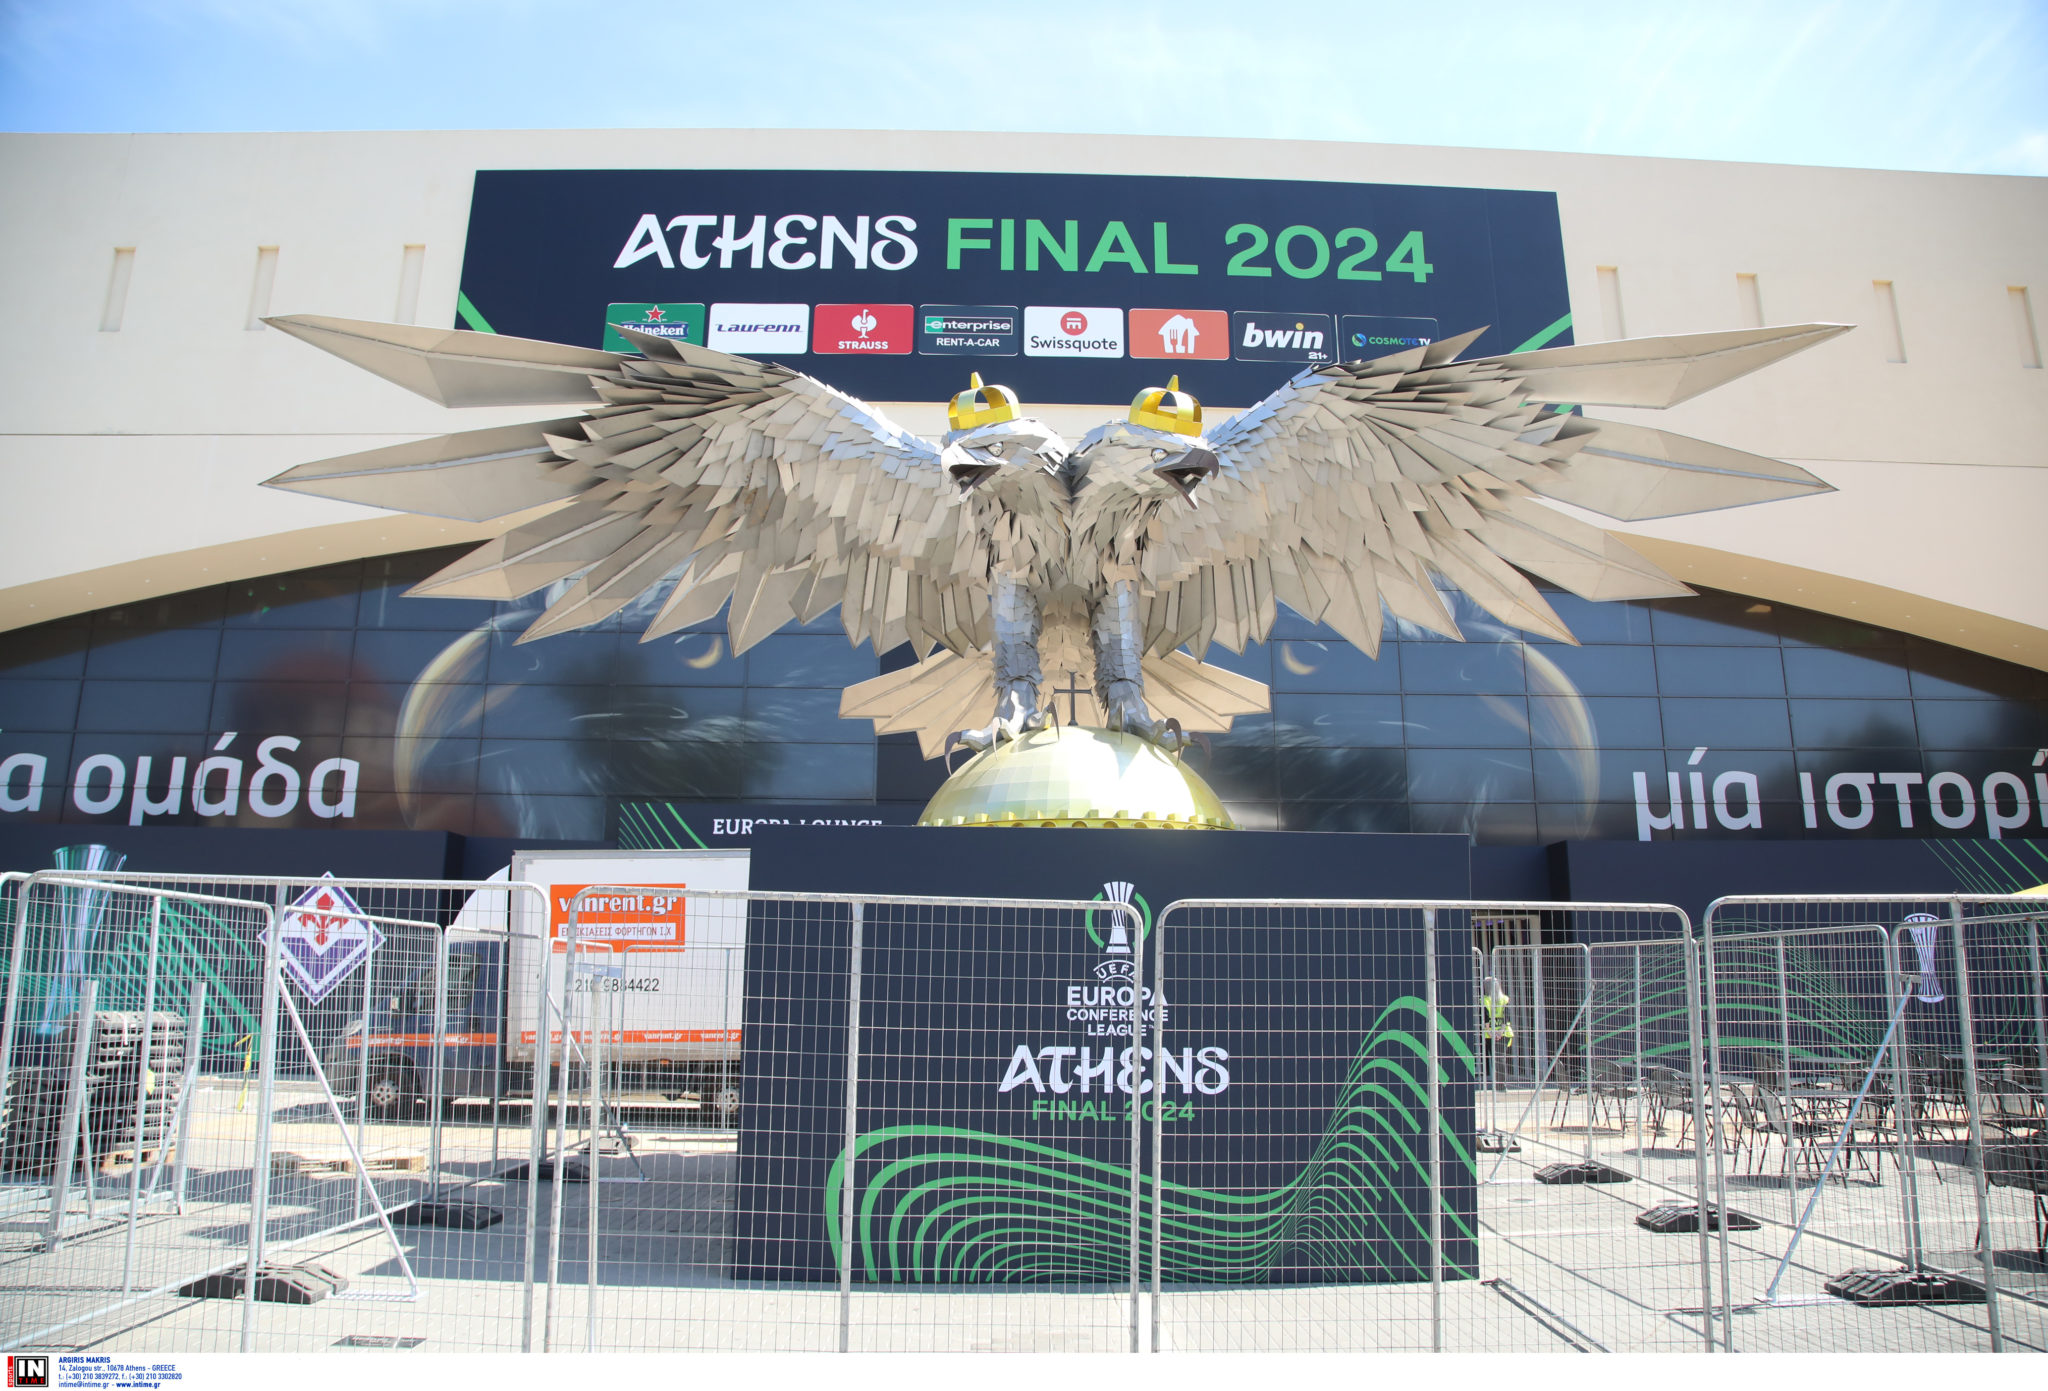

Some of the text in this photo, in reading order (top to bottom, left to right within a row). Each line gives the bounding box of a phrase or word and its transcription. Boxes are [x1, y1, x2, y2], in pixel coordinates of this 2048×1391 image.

[613, 213, 1435, 284] ATHENS FINAL 2024
[930, 320, 1011, 332] enterprise
[1242, 322, 1324, 349] bwin
[838, 341, 889, 350] STRAUSS
[936, 338, 1000, 347] RENT-A-CAR
[1030, 336, 1118, 352] Swissquote
[1308, 352, 1329, 360] 21+
[73, 731, 360, 826] ομάδα
[1632, 747, 1762, 841] μία
[998, 1044, 1231, 1095] ATHENS
[1032, 1100, 1117, 1121] FINAL
